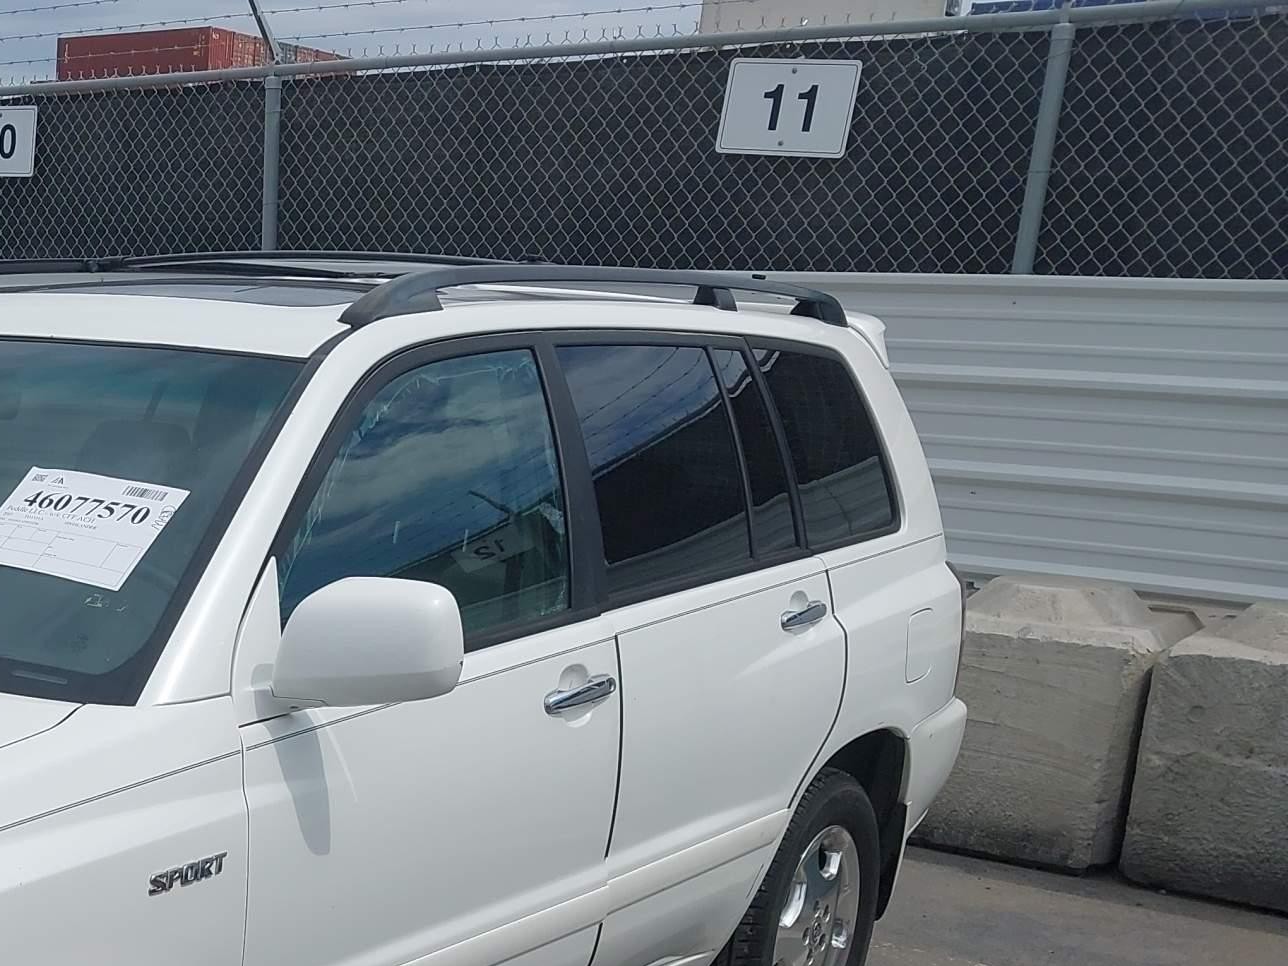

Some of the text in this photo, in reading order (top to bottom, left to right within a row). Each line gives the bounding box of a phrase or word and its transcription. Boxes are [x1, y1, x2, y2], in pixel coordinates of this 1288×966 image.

[763, 83, 819, 133] 11
[23, 490, 151, 525] 46077570
[148, 851, 228, 896] SPORT
